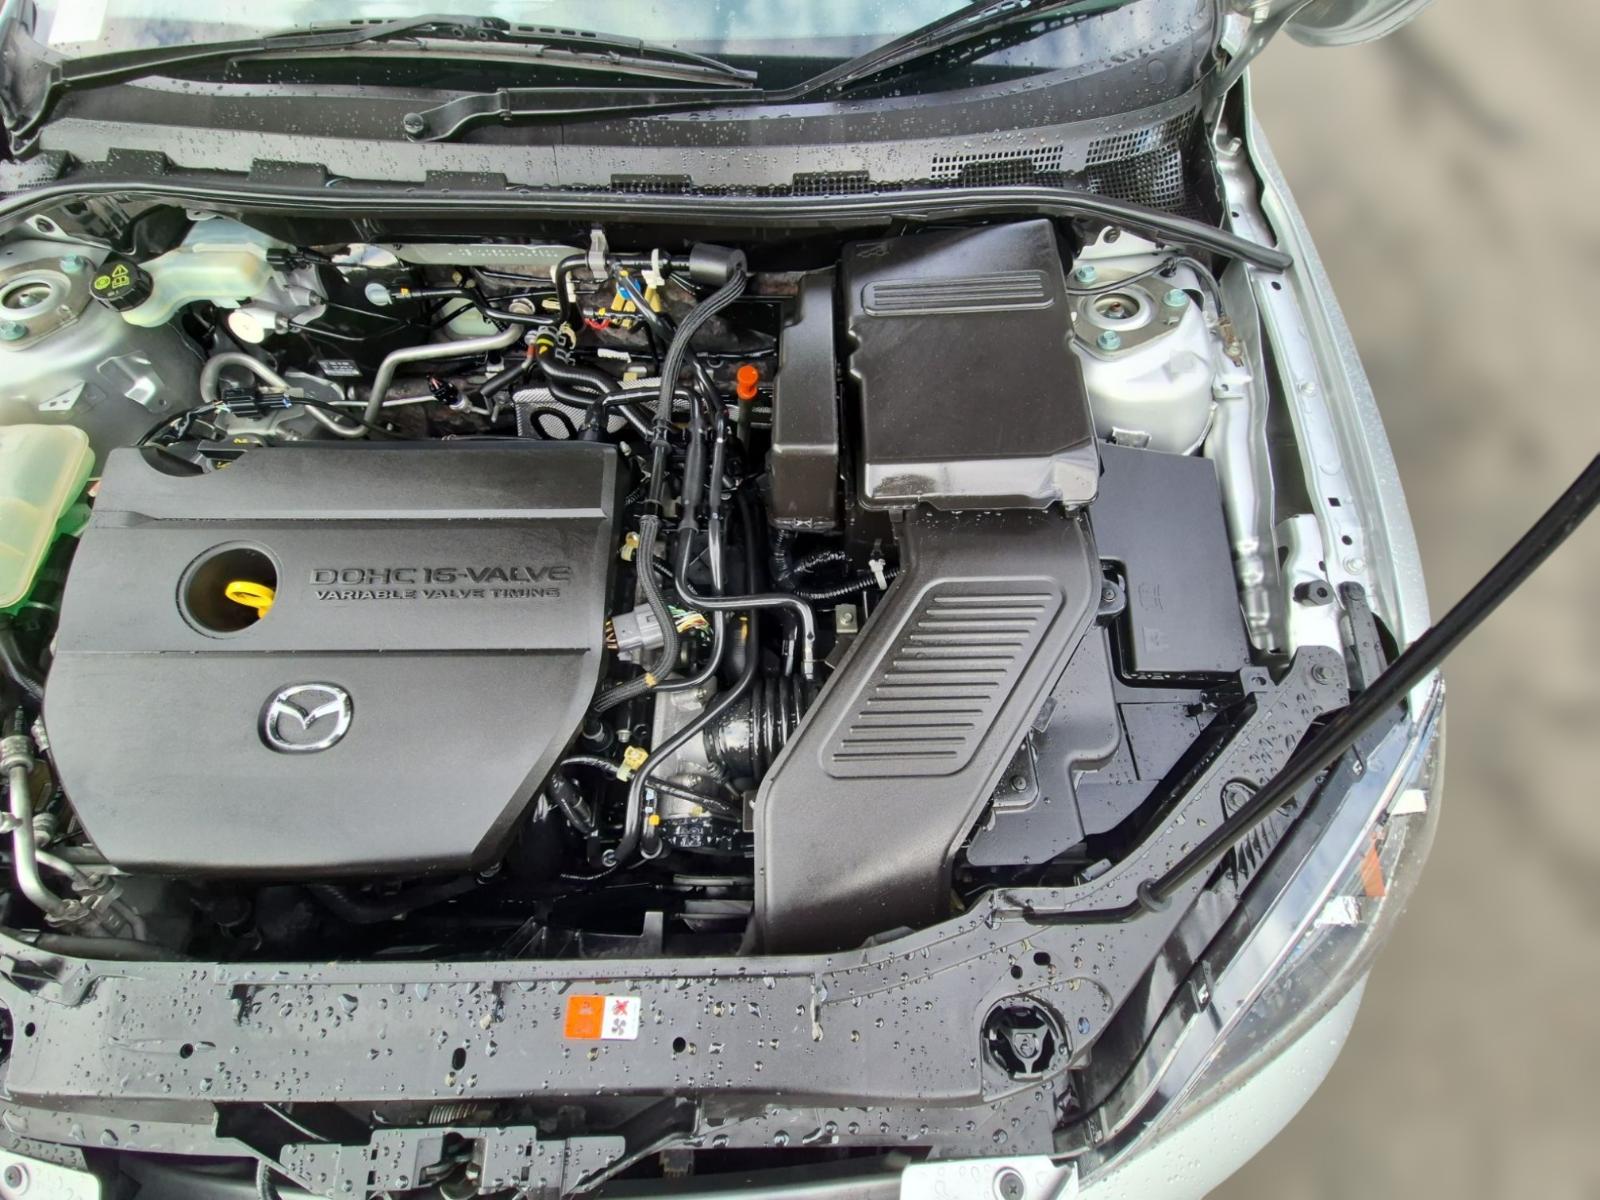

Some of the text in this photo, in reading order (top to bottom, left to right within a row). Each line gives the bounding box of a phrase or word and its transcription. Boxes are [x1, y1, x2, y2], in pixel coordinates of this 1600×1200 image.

[309, 566, 572, 585] DOHC 16-VALVE
[315, 587, 561, 601] VARIABLE VALVE TIMING
